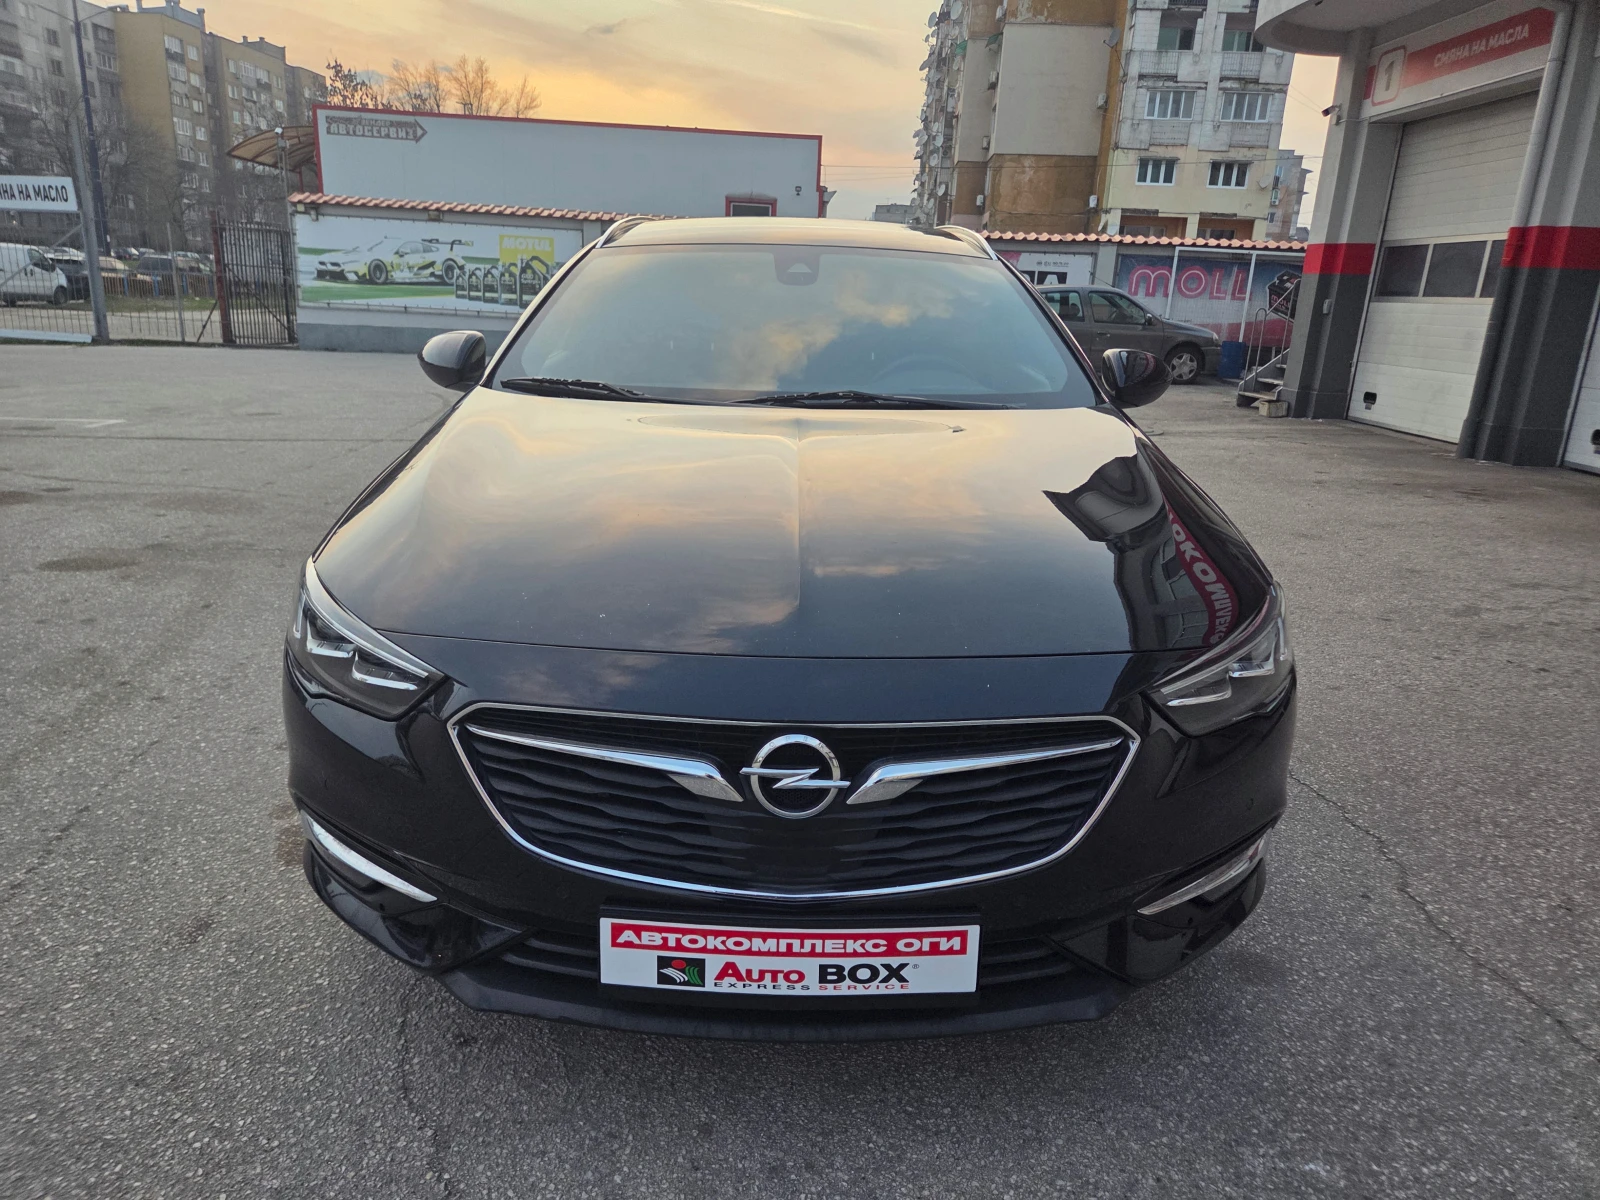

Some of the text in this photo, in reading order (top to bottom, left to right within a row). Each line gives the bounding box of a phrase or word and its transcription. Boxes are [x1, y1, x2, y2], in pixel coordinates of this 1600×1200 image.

[1433, 24, 1530, 68] СМЯНА НА МАСЛА
[1384, 59, 1396, 92] 1
[330, 123, 414, 140] АВТОСЕРВИЗ
[16, 183, 33, 202] НА
[32, 184, 69, 203] МАСЛО
[502, 236, 552, 252] MOTUL
[615, 929, 961, 953] АВТОКОМПЛЕКС ОГИ
[818, 962, 910, 985] BOX
[713, 982, 910, 991] EXPRESS SERVICE
